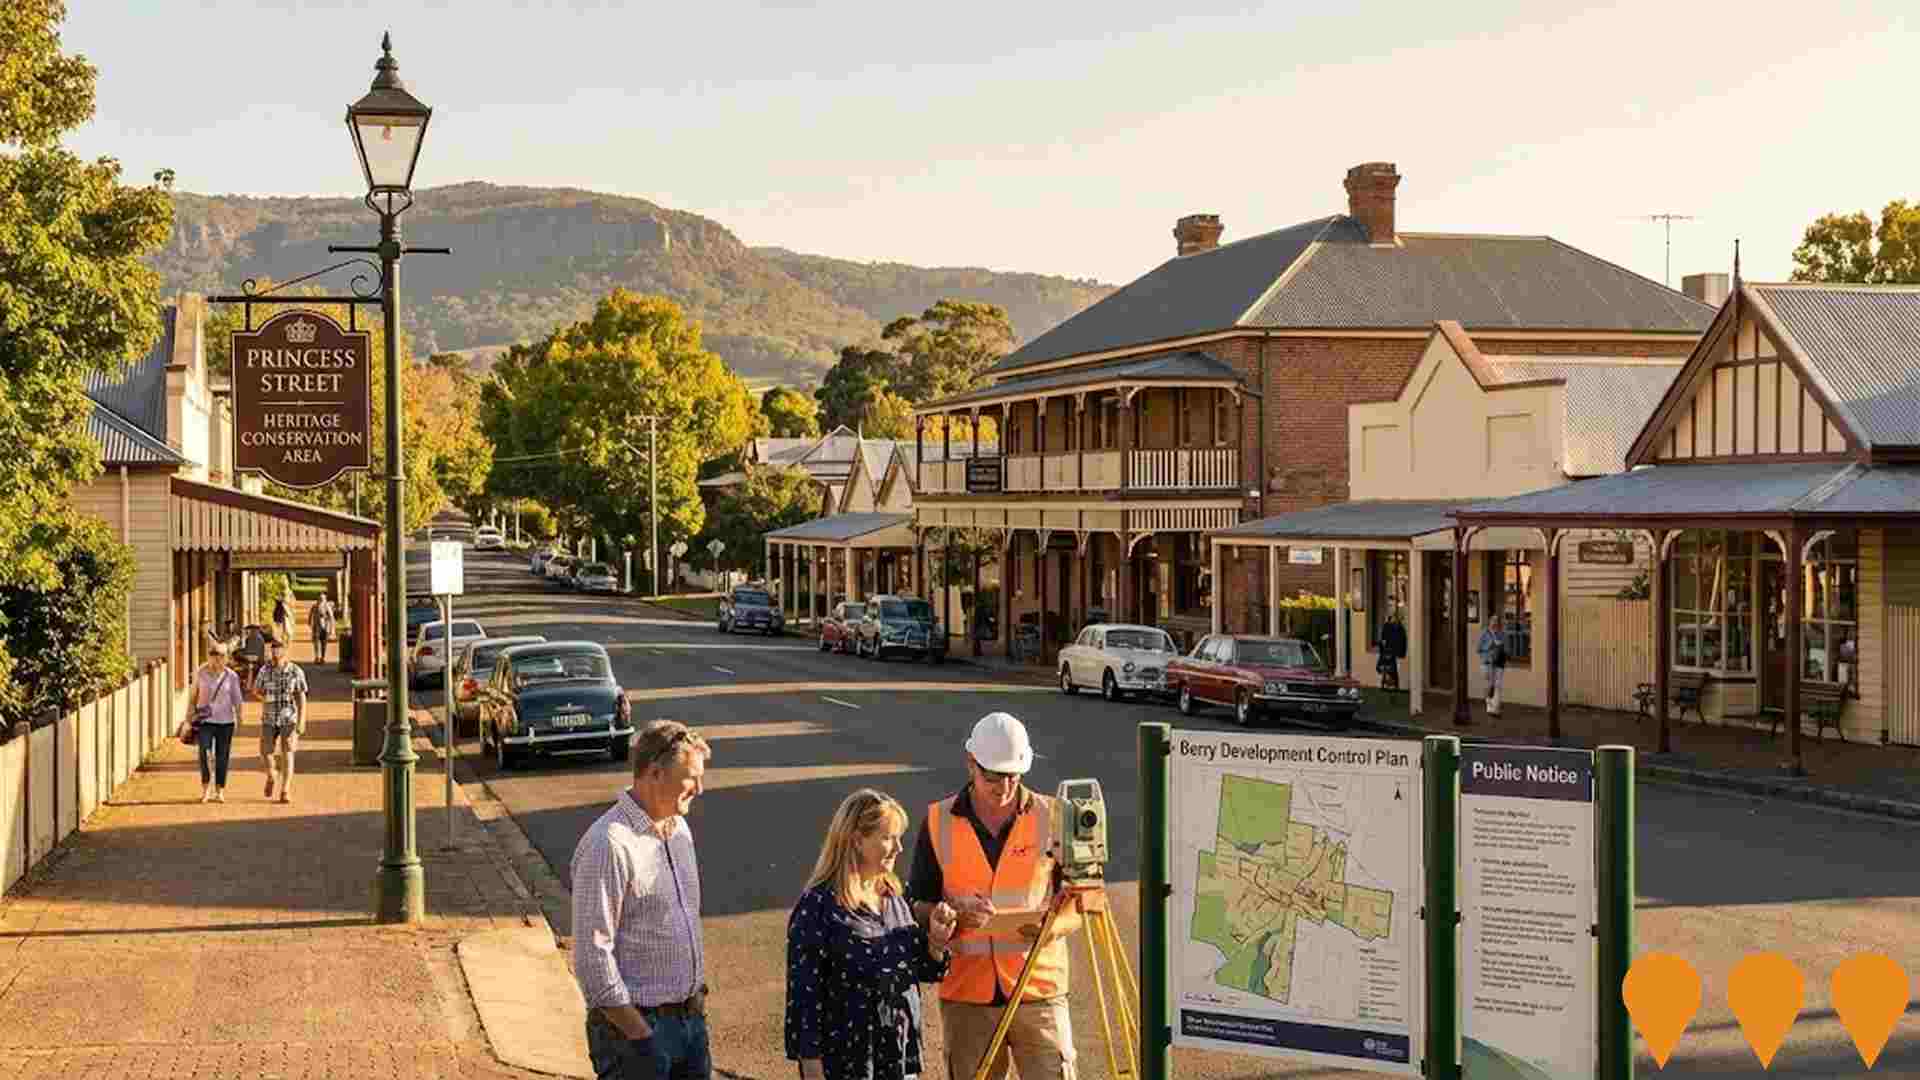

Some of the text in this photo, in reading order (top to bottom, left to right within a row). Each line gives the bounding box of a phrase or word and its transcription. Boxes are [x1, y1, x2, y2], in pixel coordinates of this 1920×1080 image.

[247, 349, 355, 369] PRINCESS
[260, 373, 344, 393] STREET
[263, 413, 341, 428] HERITAGE
[241, 431, 362, 446] CONSERVATION
[281, 449, 323, 464] AREA
[1180, 739, 1409, 767] Berry Development Control Plan
[1472, 761, 1577, 784] Public Notice
